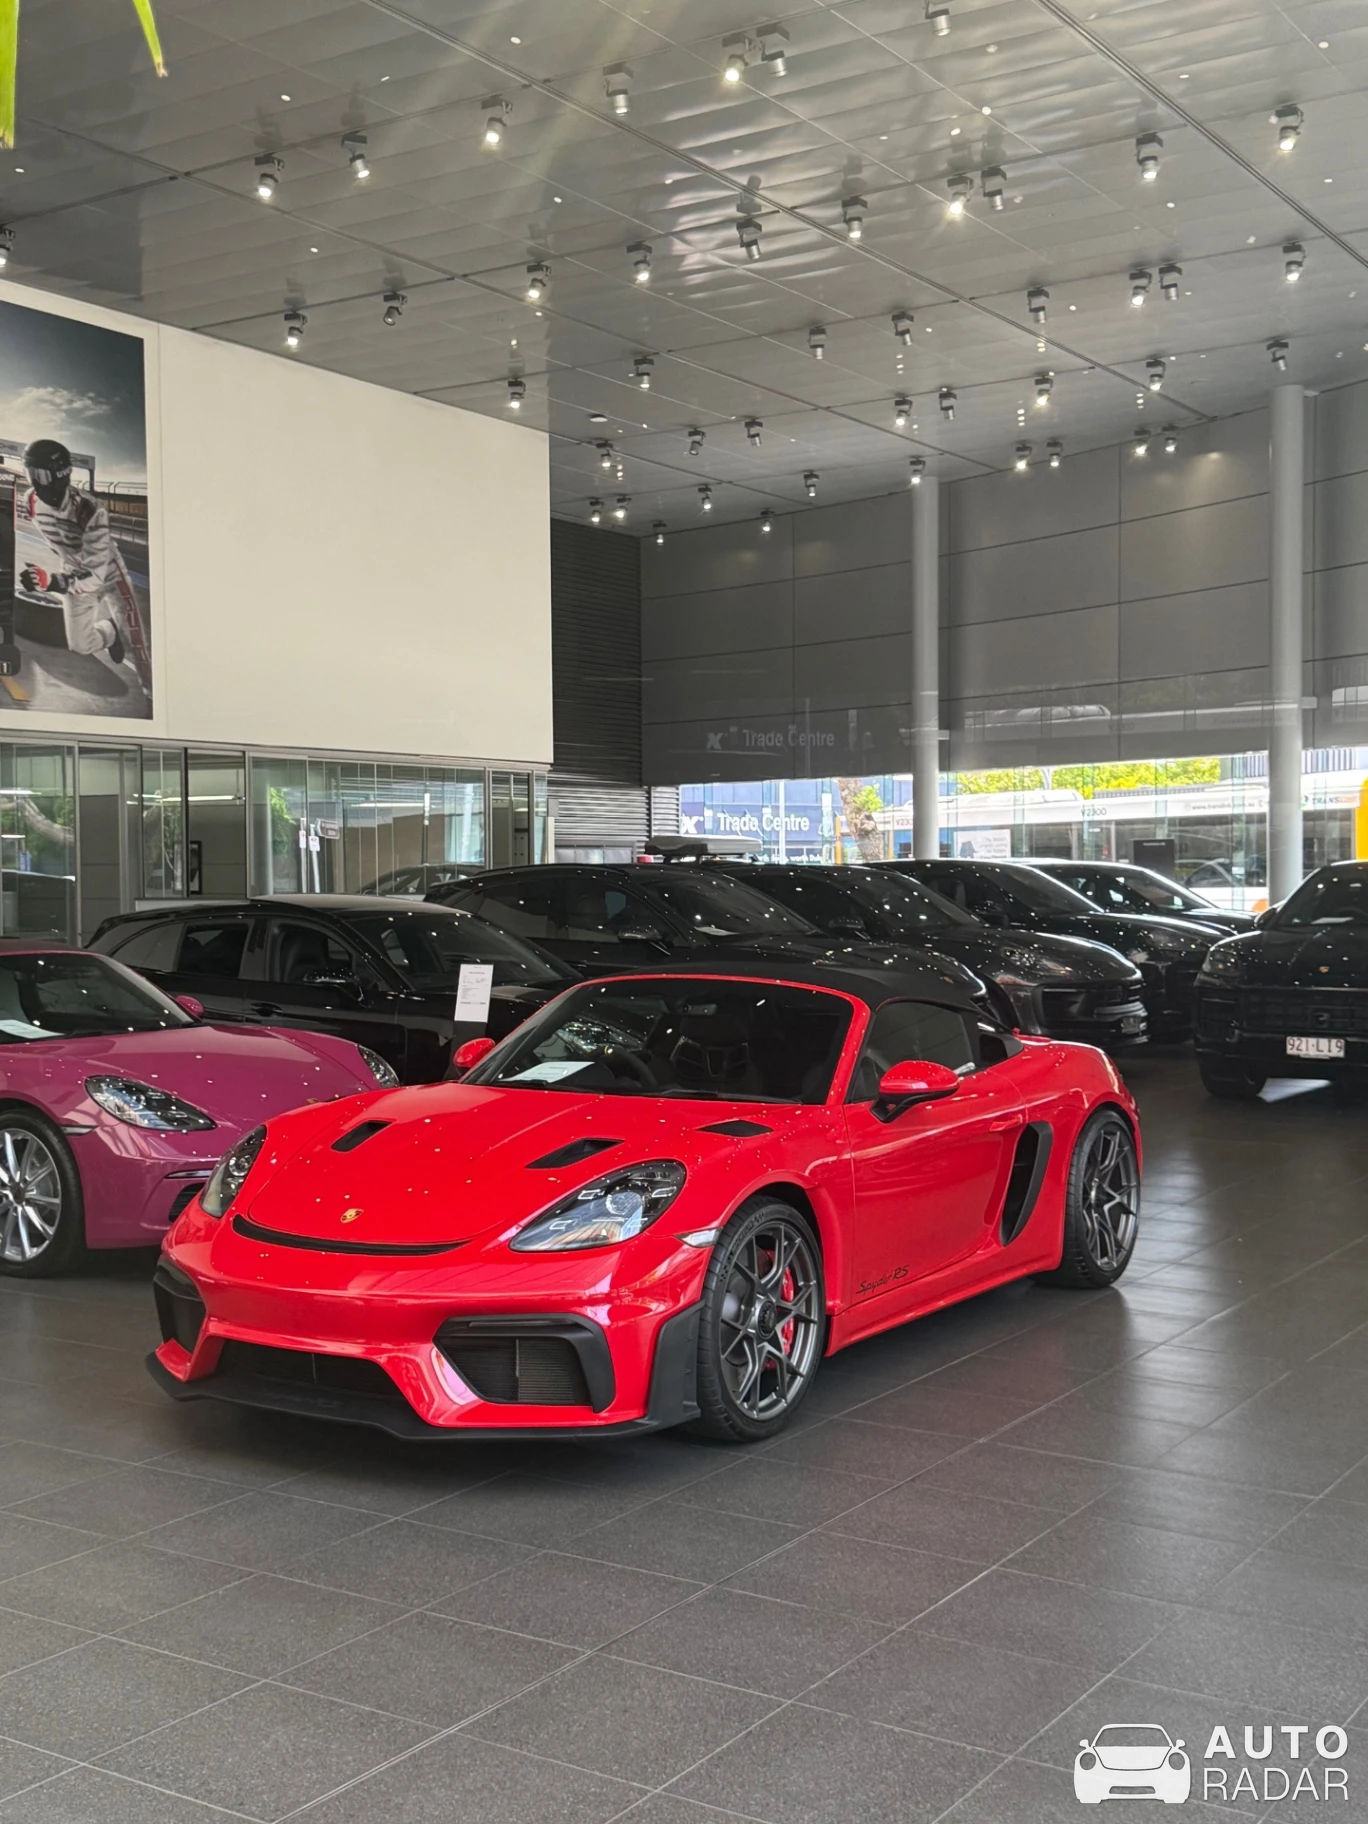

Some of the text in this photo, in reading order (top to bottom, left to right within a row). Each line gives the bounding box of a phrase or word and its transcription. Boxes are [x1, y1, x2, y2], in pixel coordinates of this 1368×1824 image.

[743, 729, 783, 747] Trade
[788, 732, 835, 747] Centre
[717, 812, 759, 831] Trade
[762, 814, 810, 831] Centre
[856, 1265, 909, 1295] Spyder RS
